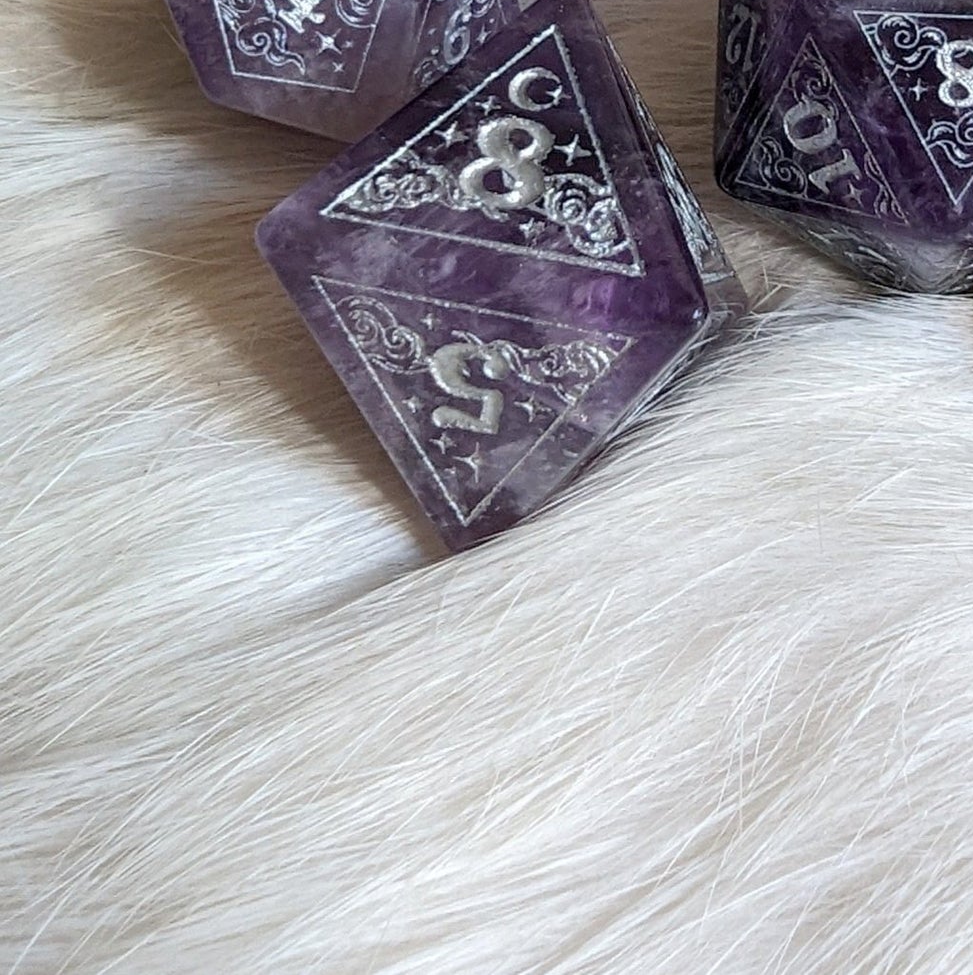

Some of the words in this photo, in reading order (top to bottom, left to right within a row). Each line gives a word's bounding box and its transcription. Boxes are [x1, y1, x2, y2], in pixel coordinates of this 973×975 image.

[457, 115, 556, 210] 8
[783, 100, 862, 194] 10
[428, 340, 509, 435] 5
